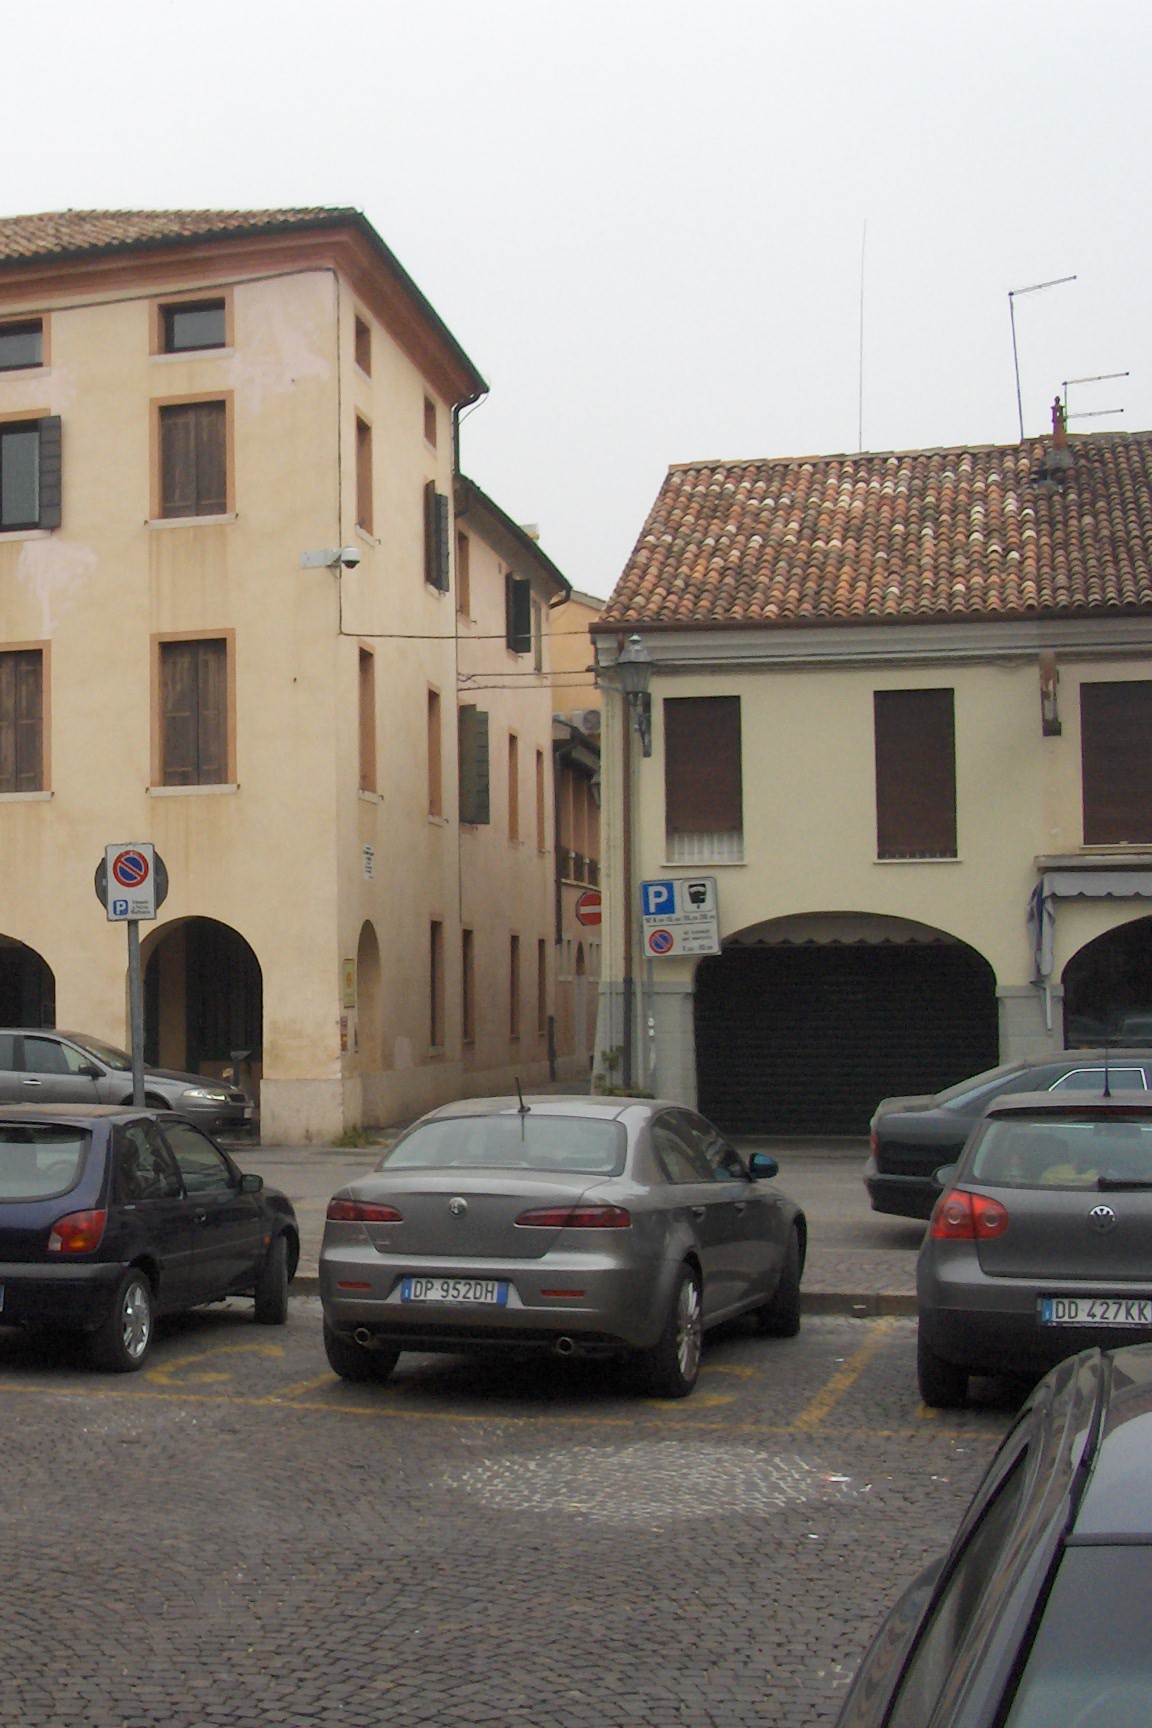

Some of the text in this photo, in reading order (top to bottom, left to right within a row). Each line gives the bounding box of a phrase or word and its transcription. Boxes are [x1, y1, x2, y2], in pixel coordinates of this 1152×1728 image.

[116, 901, 127, 914] P
[649, 886, 668, 913] P
[413, 1280, 495, 1301] DP 952DH
[1055, 1301, 1148, 1322] DD 427KK
